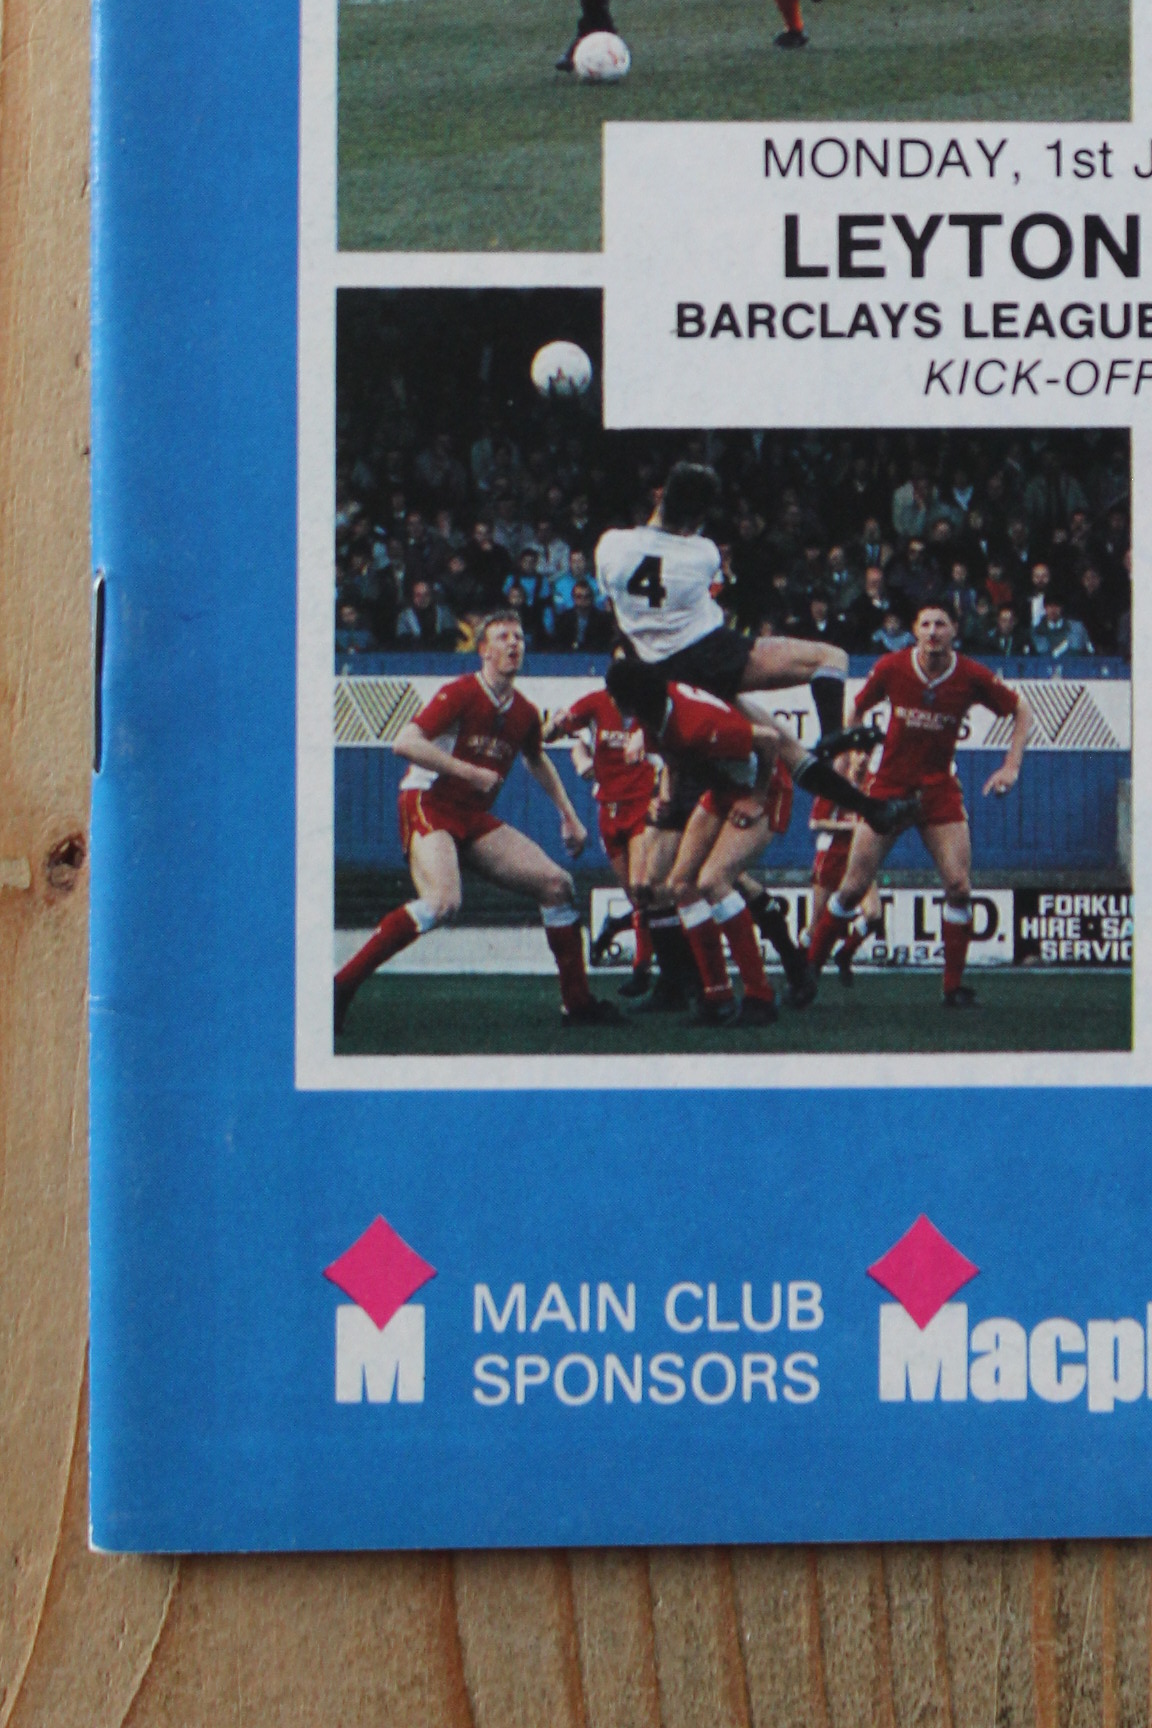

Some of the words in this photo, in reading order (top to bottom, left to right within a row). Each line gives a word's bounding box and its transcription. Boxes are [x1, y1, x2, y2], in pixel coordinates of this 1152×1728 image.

[763, 138, 1021, 185] MONDAY,
[1045, 140, 1113, 179] 1st
[783, 212, 1142, 281] LEYTON
[675, 301, 942, 340] BARCLAYS
[626, 555, 667, 610] 4
[1020, 917, 1081, 940] HIRE
[473, 1282, 637, 1334] MAIN
[664, 1279, 825, 1333] CLUB
[335, 1303, 426, 1403] M
[471, 1352, 822, 1406] SPONSORS
